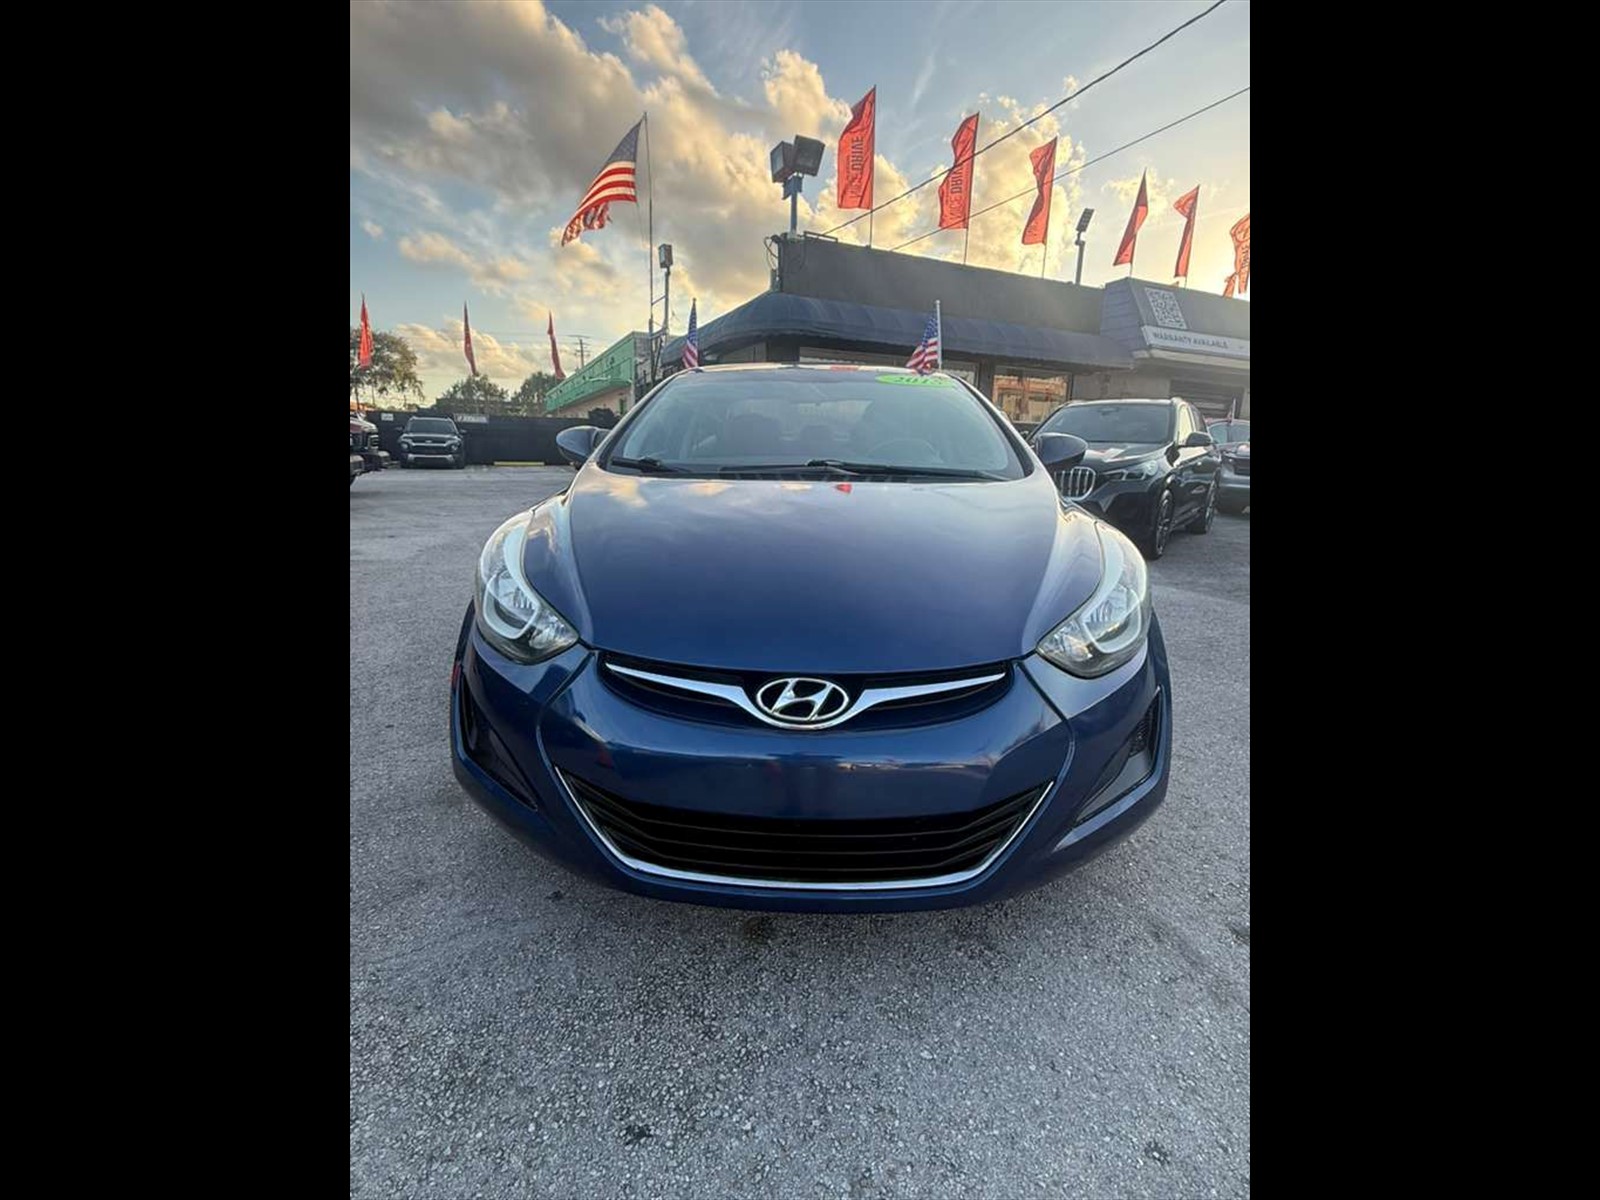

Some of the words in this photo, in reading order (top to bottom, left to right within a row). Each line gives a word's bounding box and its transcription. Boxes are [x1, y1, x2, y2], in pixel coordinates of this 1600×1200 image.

[851, 136, 864, 170] DRIVE
[950, 167, 963, 194] DRIV
[1153, 332, 1191, 344] WARRANTY
